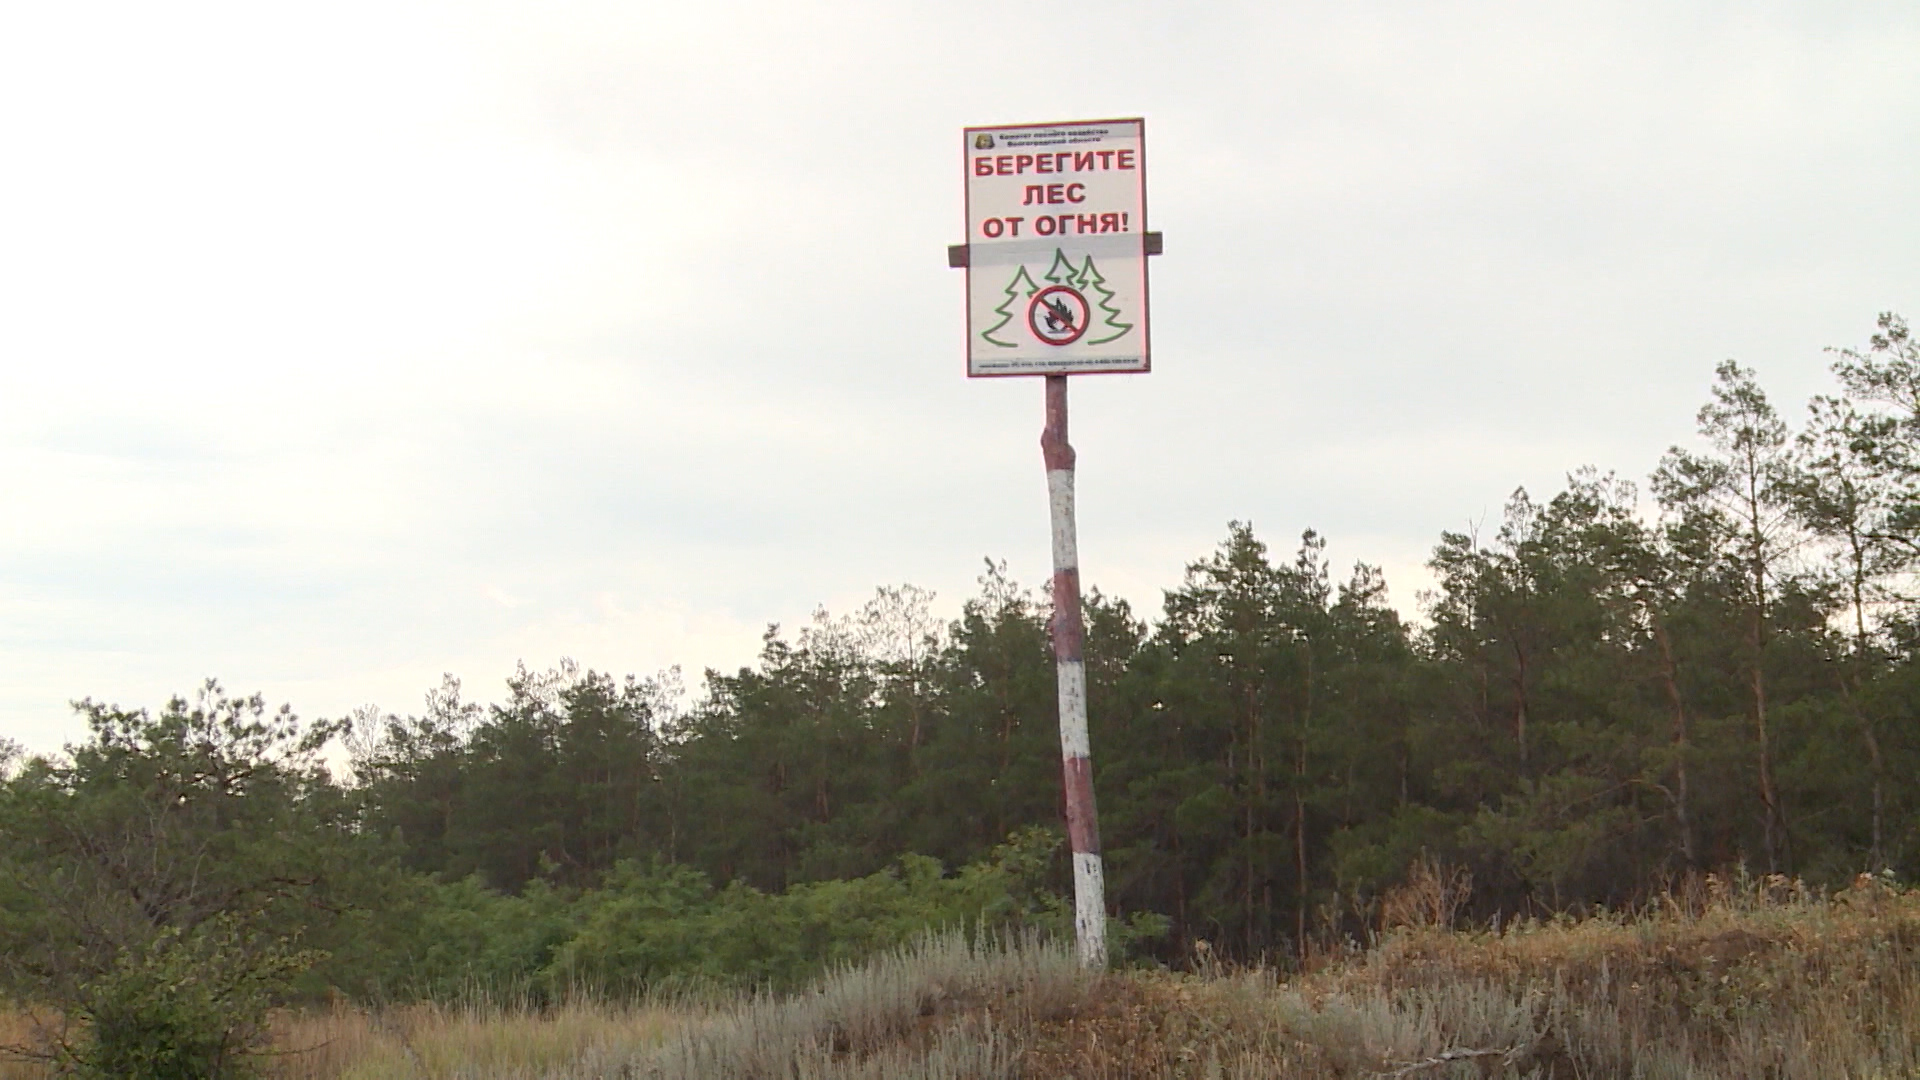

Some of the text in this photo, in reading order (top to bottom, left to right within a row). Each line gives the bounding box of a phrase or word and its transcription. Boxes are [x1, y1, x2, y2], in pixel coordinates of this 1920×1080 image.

[975, 149, 1135, 176] БЕРЕГИТЕ
[1023, 183, 1086, 205] ЛЕС
[983, 212, 1129, 238] ОТ ОГНЯ!
